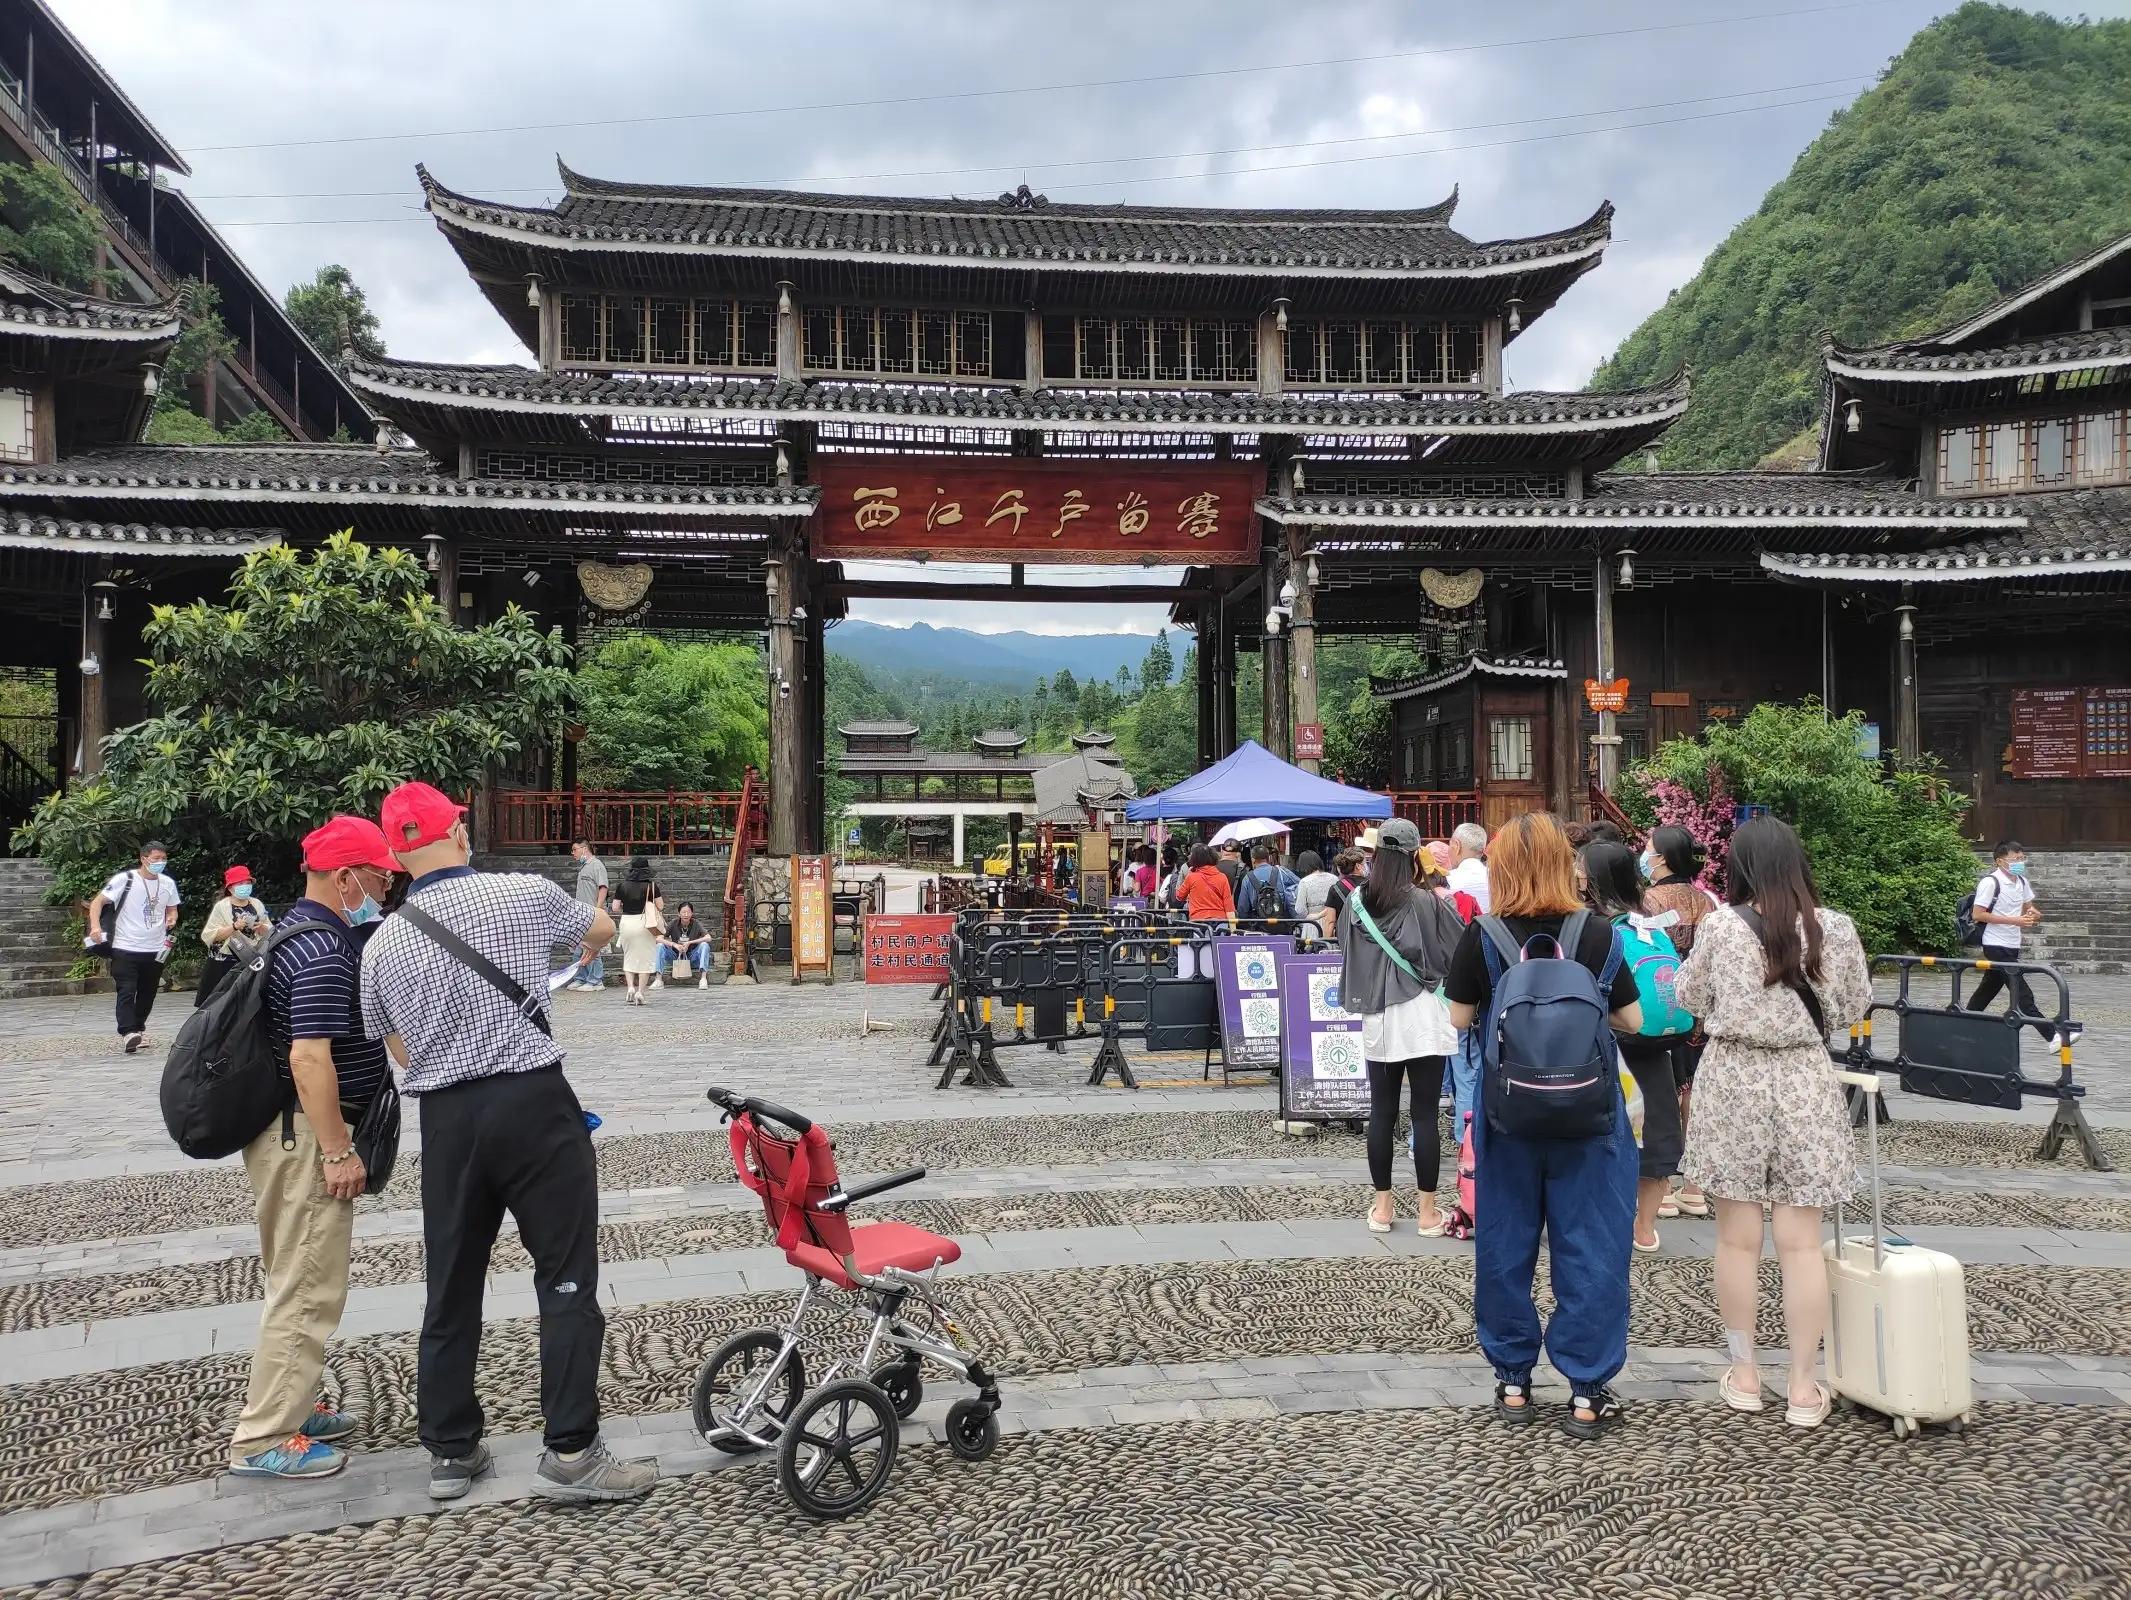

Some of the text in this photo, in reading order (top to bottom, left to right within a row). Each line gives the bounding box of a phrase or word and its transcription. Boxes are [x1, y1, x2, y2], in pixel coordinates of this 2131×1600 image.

[853, 486, 1221, 539] 西江千户苗寨
[871, 934, 950, 949] 村民商户请
[871, 952, 950, 968] 走村民通道
[1326, 1023, 1348, 1032] 行程码
